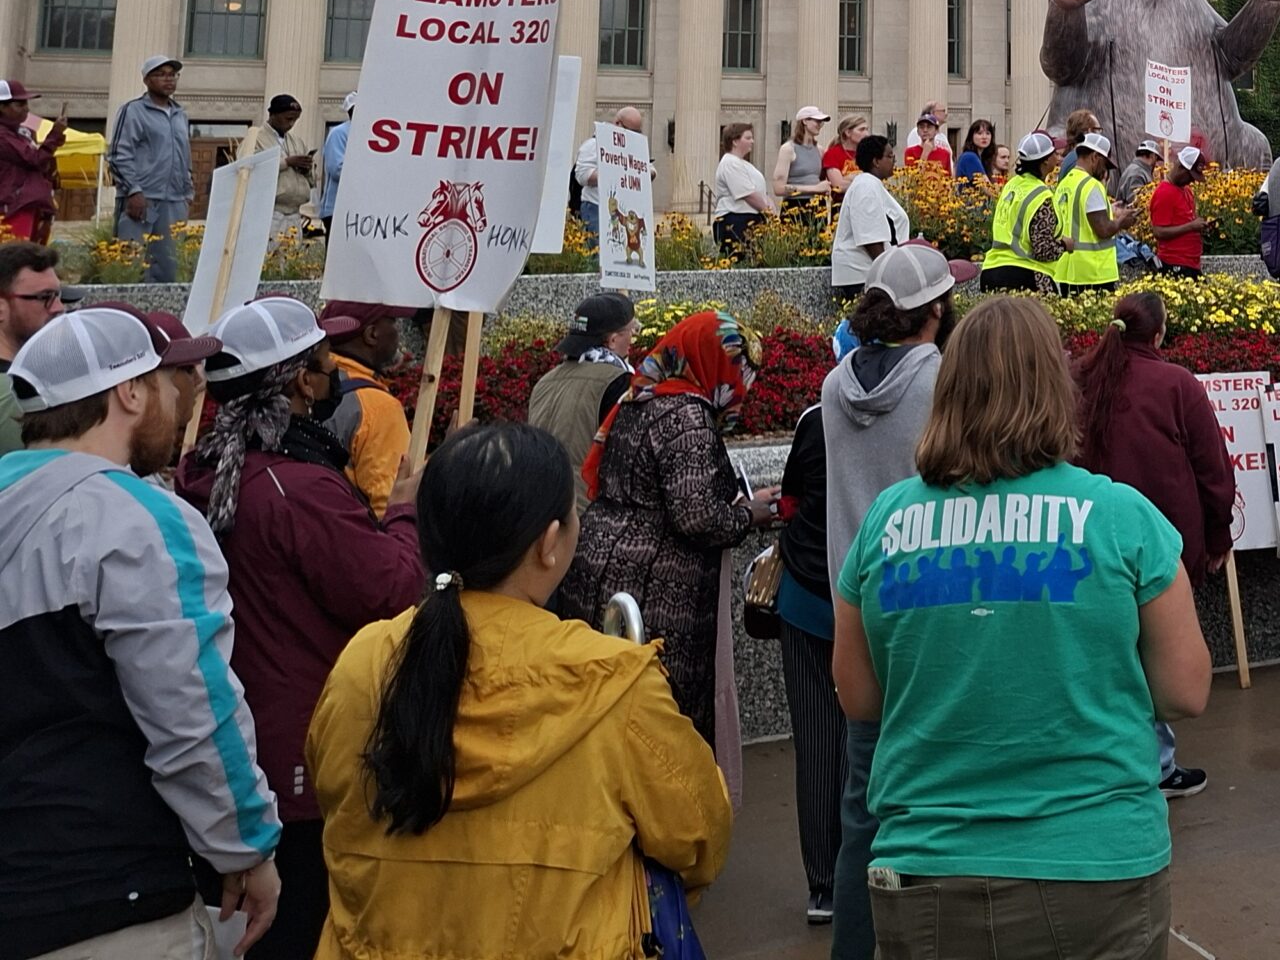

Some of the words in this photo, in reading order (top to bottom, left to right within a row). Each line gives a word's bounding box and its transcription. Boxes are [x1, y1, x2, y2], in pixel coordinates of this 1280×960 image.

[396, 14, 500, 44] LOCAL
[510, 19, 550, 44] 320
[1147, 62, 1188, 76] TEAMSTERS
[1148, 72, 1169, 82] LOCAL
[1171, 77, 1186, 85] 320
[448, 72, 504, 106] ON
[1159, 85, 1172, 97] ON
[1147, 94, 1186, 110] STRIKE!
[367, 119, 539, 161] STRIKE!
[613, 131, 626, 147] END
[600, 147, 628, 171] Poverty
[628, 154, 648, 174] Wages
[620, 174, 628, 189] at
[628, 174, 642, 192] UMN
[346, 210, 409, 242] HONK
[487, 224, 530, 254] HONK
[1232, 398, 1260, 411] 320
[881, 493, 1094, 556] SOLIDARITY
